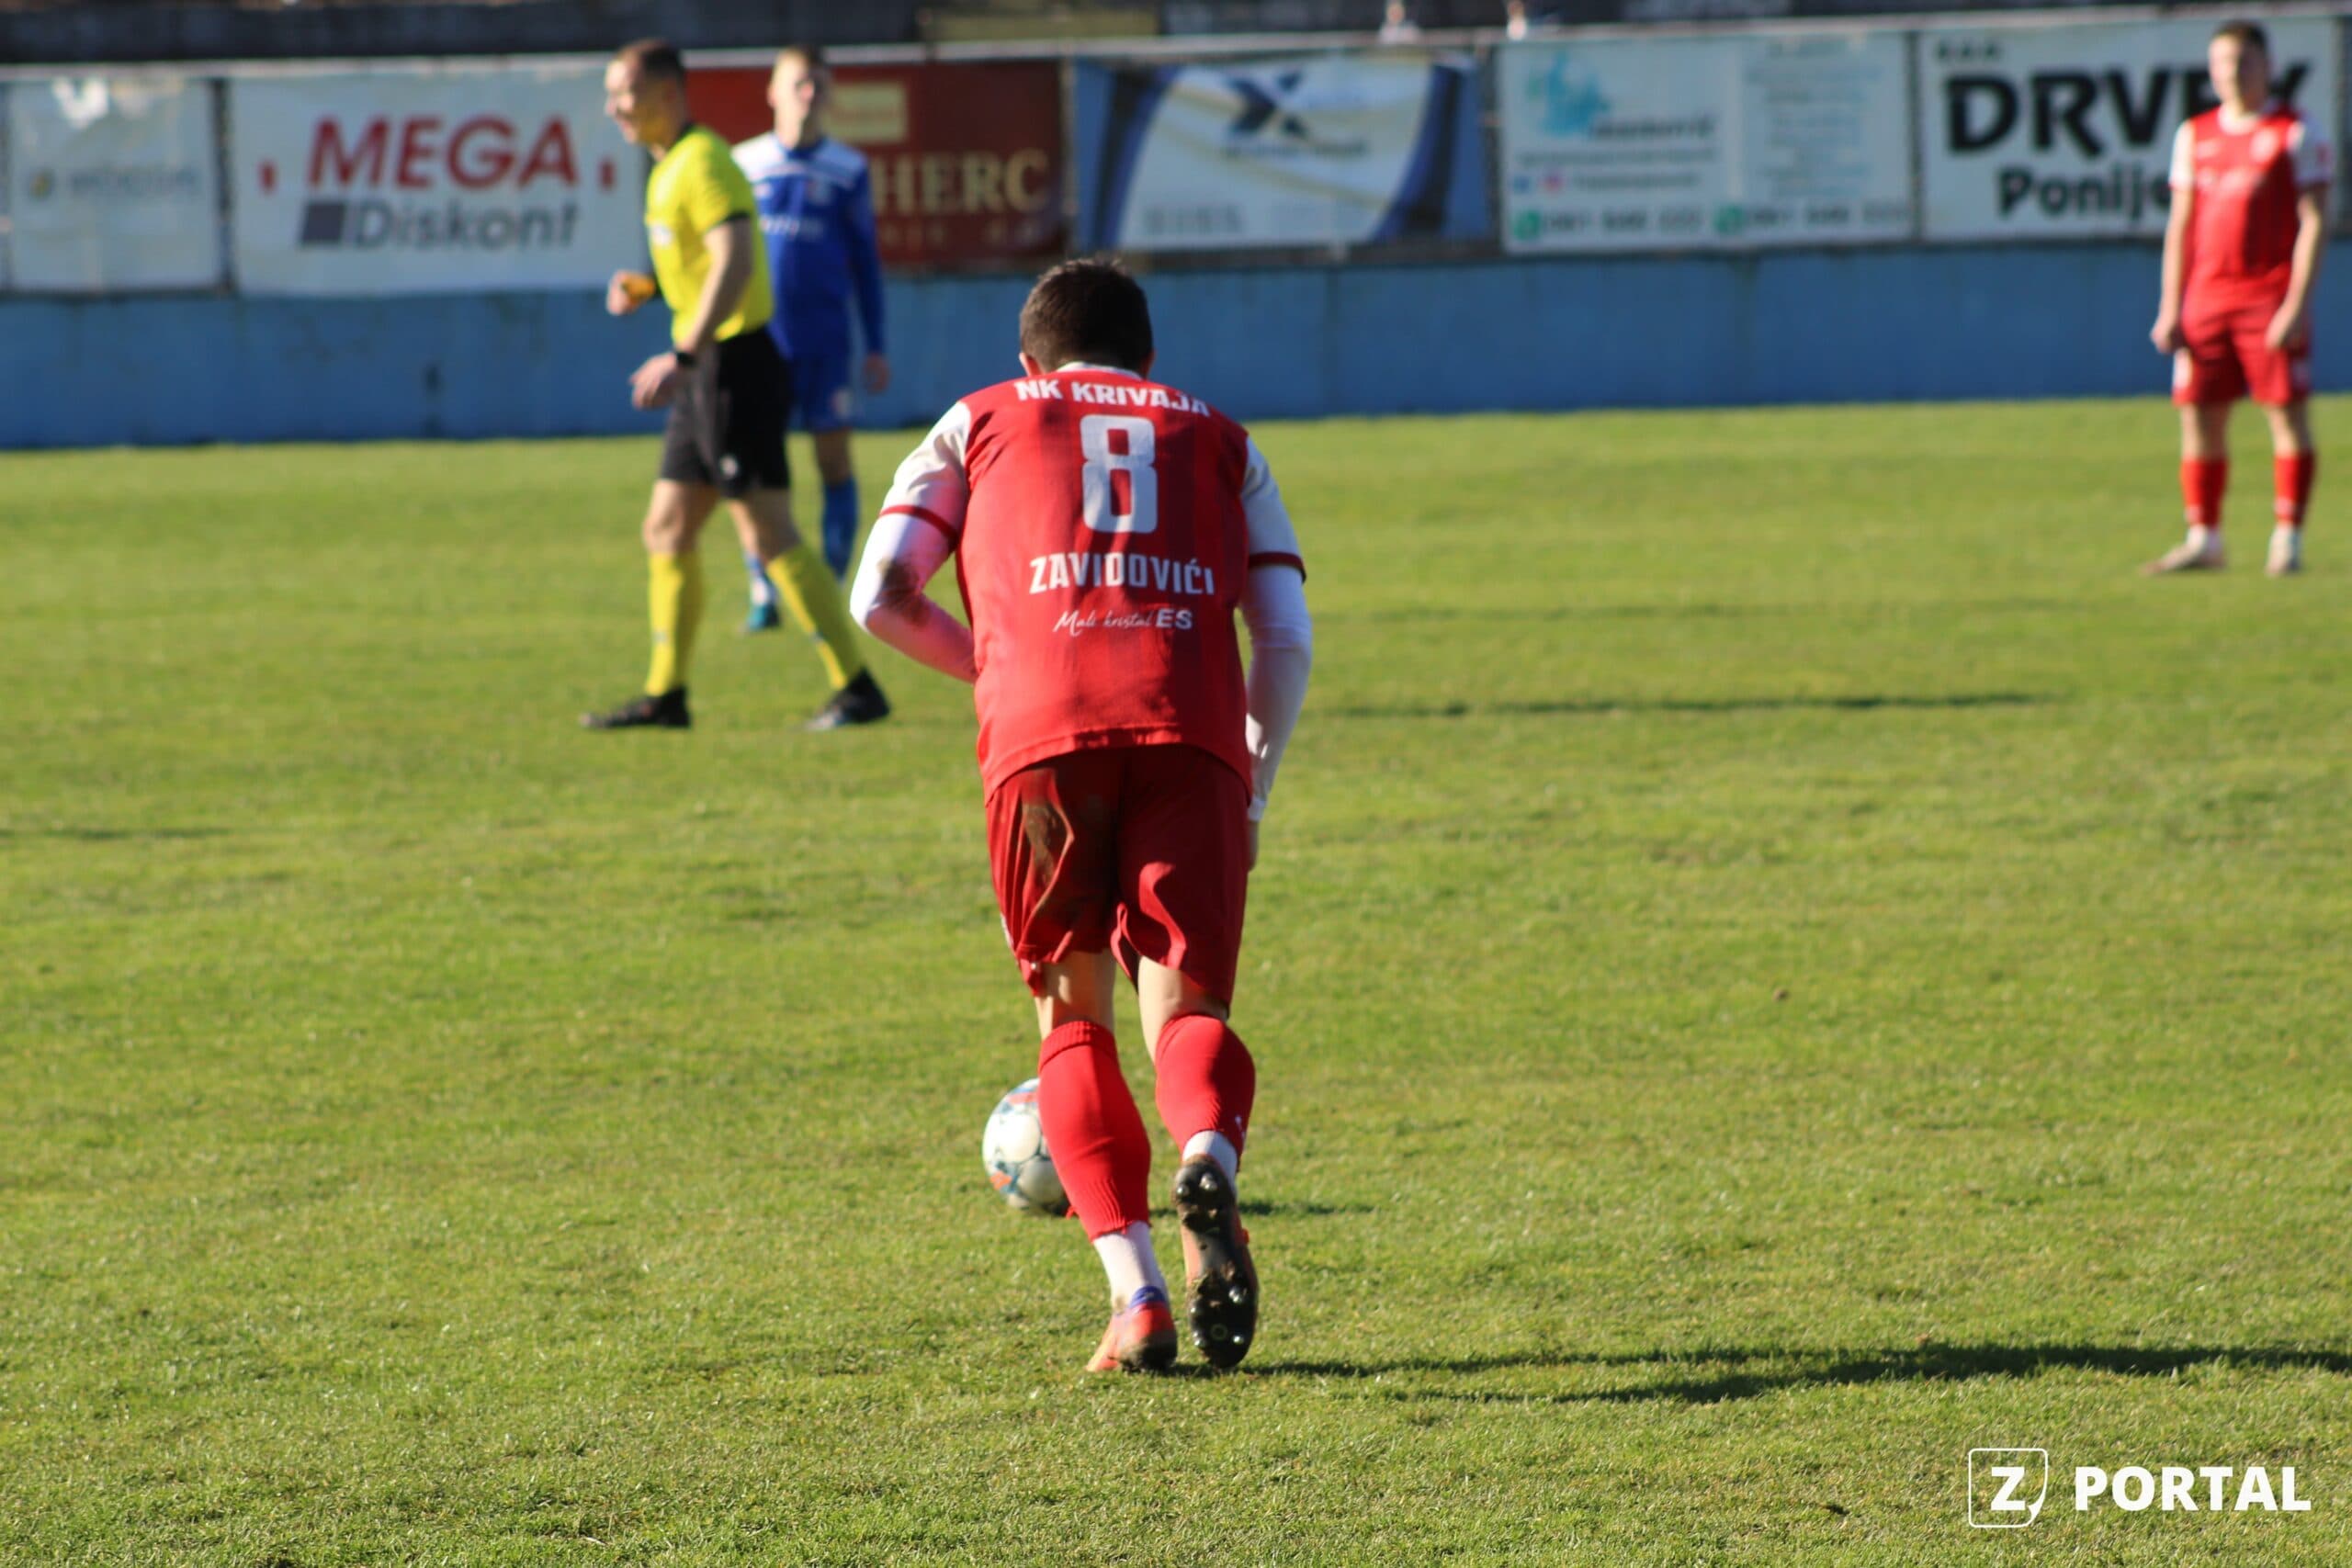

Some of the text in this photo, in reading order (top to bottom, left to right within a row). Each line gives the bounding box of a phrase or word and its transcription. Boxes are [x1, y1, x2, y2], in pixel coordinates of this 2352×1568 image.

[1943, 62, 2310, 158] DRV
[307, 113, 578, 189] MEGA
[353, 198, 580, 249] Diskont
[1014, 379, 1211, 417] NK KRIVAJA
[1080, 413, 1158, 534] 8
[1029, 552, 1216, 595] ZAVIDOVIĆI
[1052, 609, 1096, 637] Mali
[1155, 608, 1193, 630] ES
